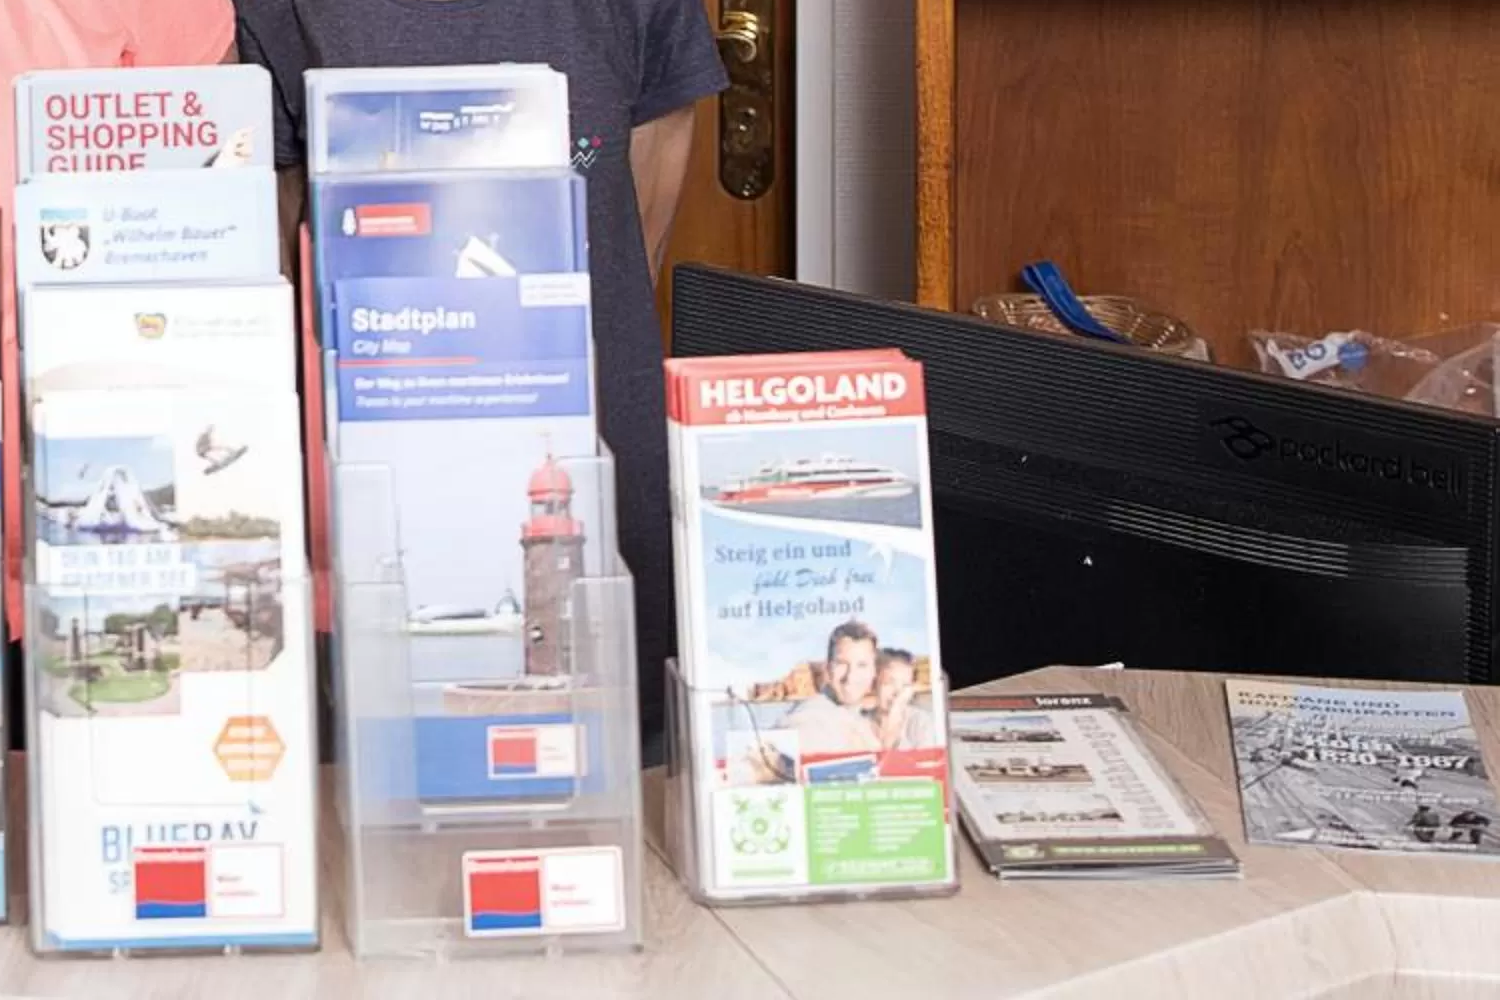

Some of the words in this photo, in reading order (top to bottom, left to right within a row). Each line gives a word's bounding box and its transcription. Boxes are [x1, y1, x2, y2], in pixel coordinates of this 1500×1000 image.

[45, 92, 172, 121] OUTLET
[182, 91, 202, 117] &
[47, 121, 218, 151] SHOPPING
[351, 307, 477, 335] Stadtplan
[700, 371, 908, 409] HELGOLAND
[715, 544, 768, 565] Steig
[772, 543, 805, 561] ein
[811, 540, 852, 558] und
[718, 601, 752, 620] auf
[757, 595, 866, 620] Helgoland
